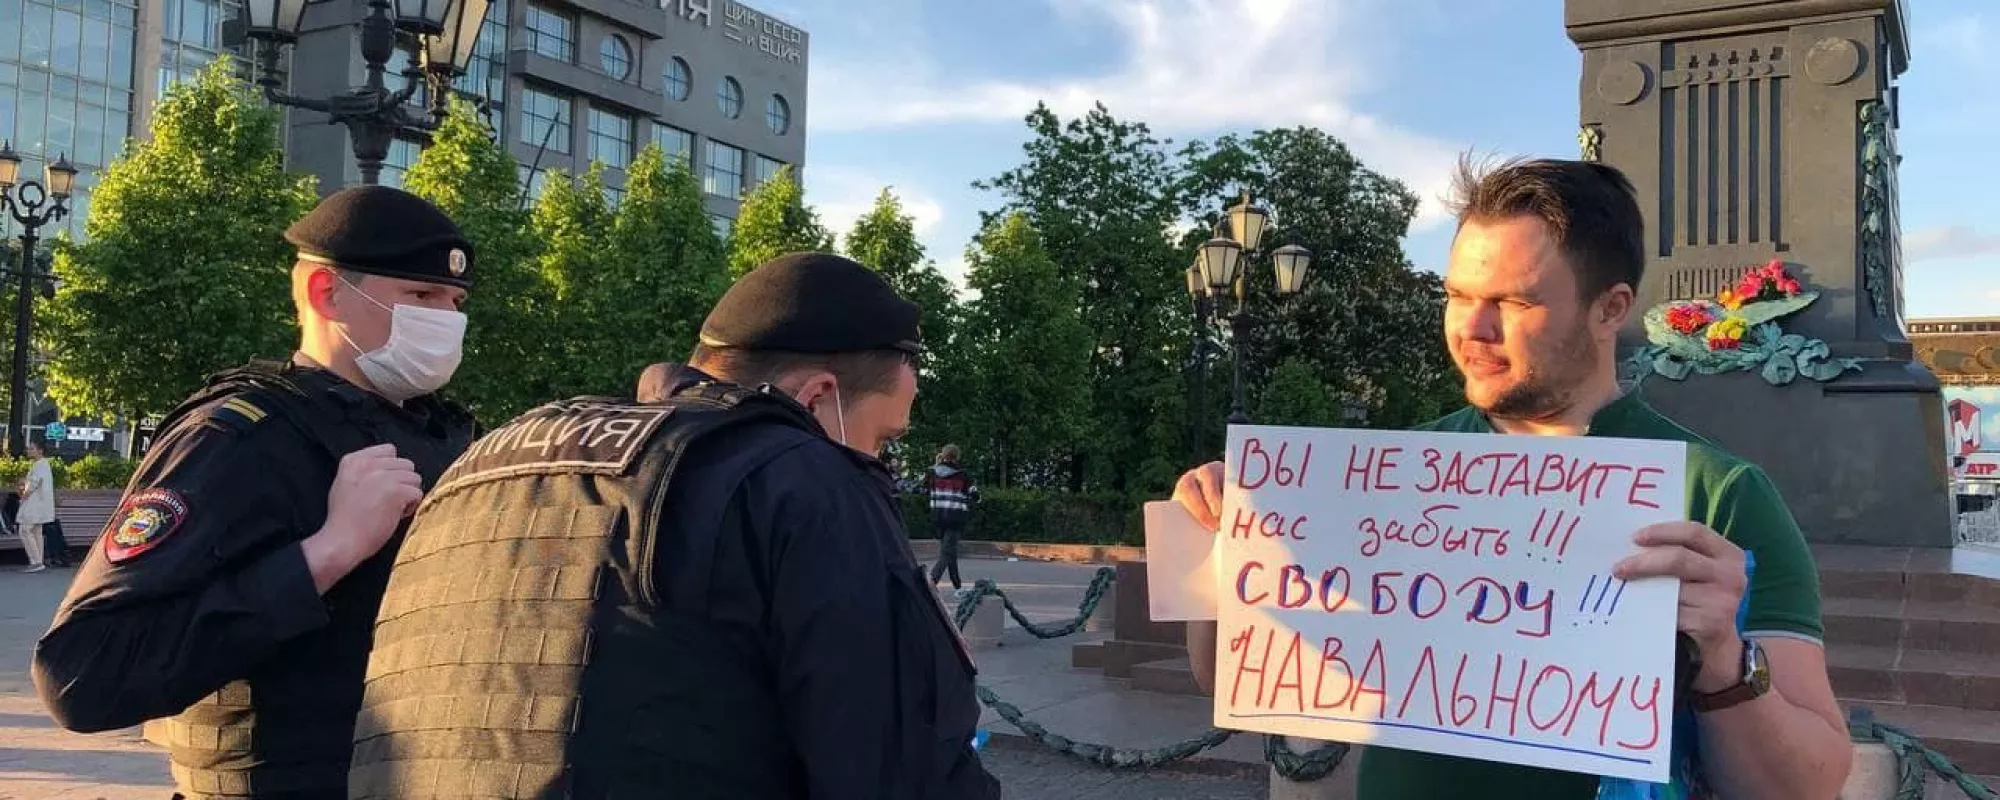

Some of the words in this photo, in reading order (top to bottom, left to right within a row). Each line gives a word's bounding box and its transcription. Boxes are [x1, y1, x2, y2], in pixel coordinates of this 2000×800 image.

[459, 415, 641, 464] ЛИЦИЯ
[1238, 438, 1312, 490] ВЫ
[1344, 444, 1404, 492] НЕ
[1415, 448, 1665, 509] ЗАСТАВИТЕ
[1231, 507, 1307, 540] нас
[1230, 624, 1661, 751] НАВАЛЬНОМУ
